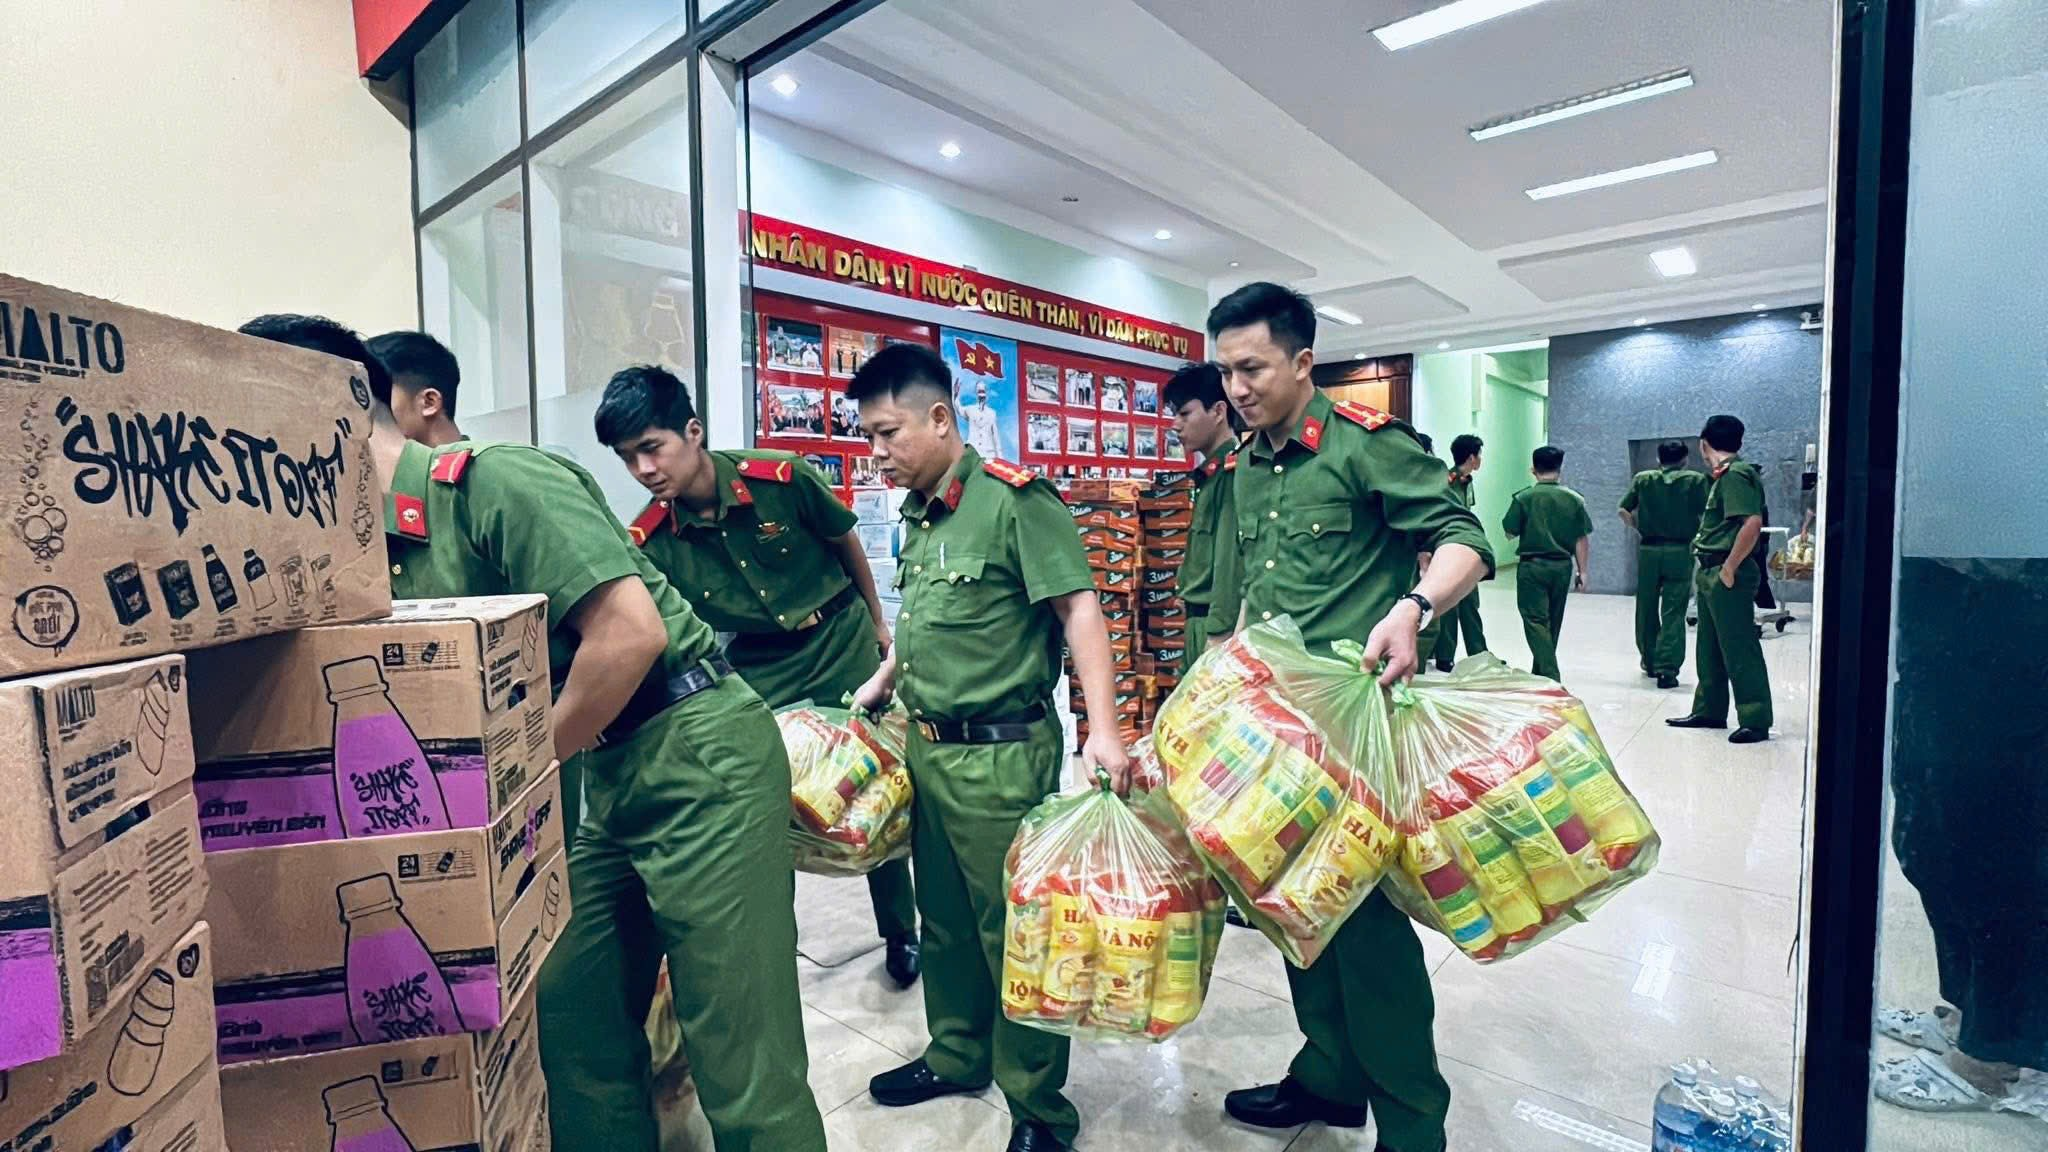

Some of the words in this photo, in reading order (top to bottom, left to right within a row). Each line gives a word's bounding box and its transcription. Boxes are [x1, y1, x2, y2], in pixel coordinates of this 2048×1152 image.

[752, 229, 827, 271] NHÂN
[833, 249, 886, 286] DÂN
[892, 262, 913, 292] VÌ
[921, 271, 978, 306] NƯỚC
[981, 287, 1032, 319] QUÊN
[1036, 301, 1084, 335] THÂN,
[1088, 311, 1103, 335] VÌ
[1106, 317, 1134, 343] DÂN
[1173, 336, 1188, 358] VỤ
